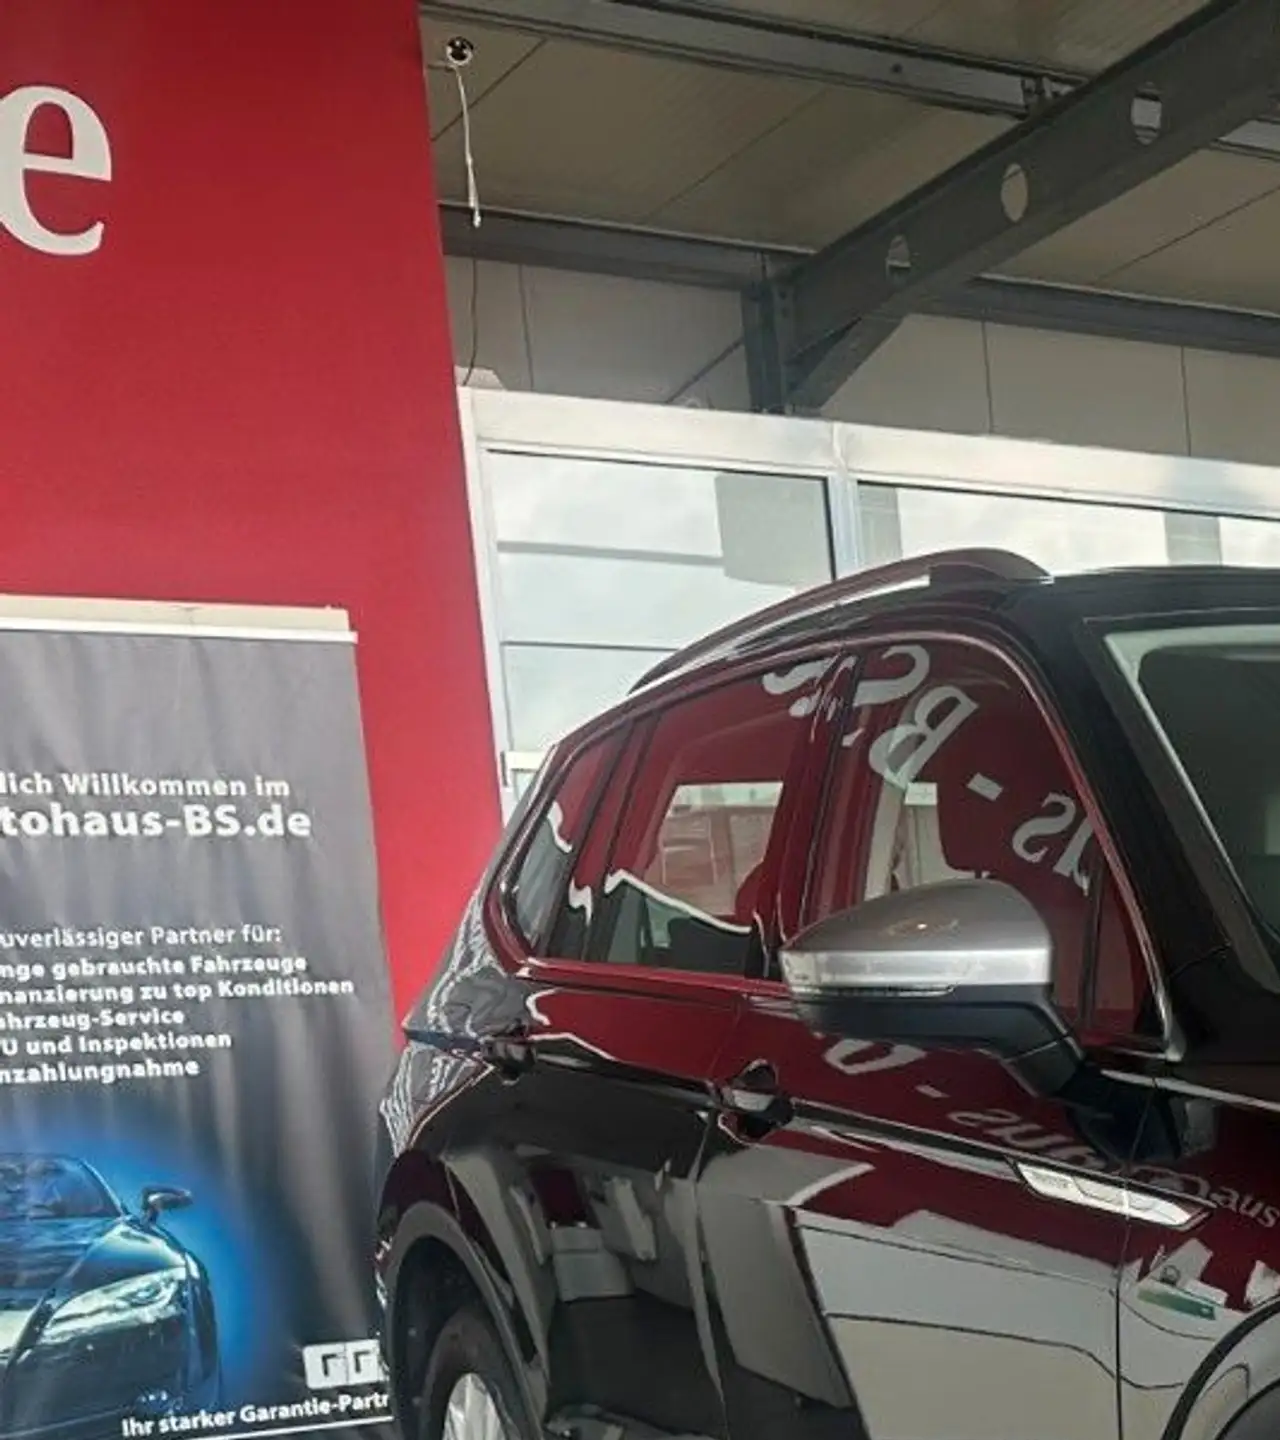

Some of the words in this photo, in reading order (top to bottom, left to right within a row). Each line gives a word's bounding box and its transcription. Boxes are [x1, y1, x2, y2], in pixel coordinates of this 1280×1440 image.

[0, 85, 112, 256] e
[60, 771, 248, 796] Willkommen
[255, 774, 290, 796] im
[0, 801, 312, 838] tohaus-BS.de
[151, 925, 236, 946] Partner
[241, 923, 283, 943] für:
[52, 956, 186, 981] gebrauchte
[190, 954, 308, 975] Fahrzeuge
[140, 985, 168, 1000] zu
[172, 982, 213, 1003] top
[217, 977, 355, 998] Konditionen
[26, 1034, 72, 1054] und
[79, 1029, 232, 1058] Inspektionen
[122, 1417, 154, 1437] Ihr
[158, 1409, 237, 1433] starker
